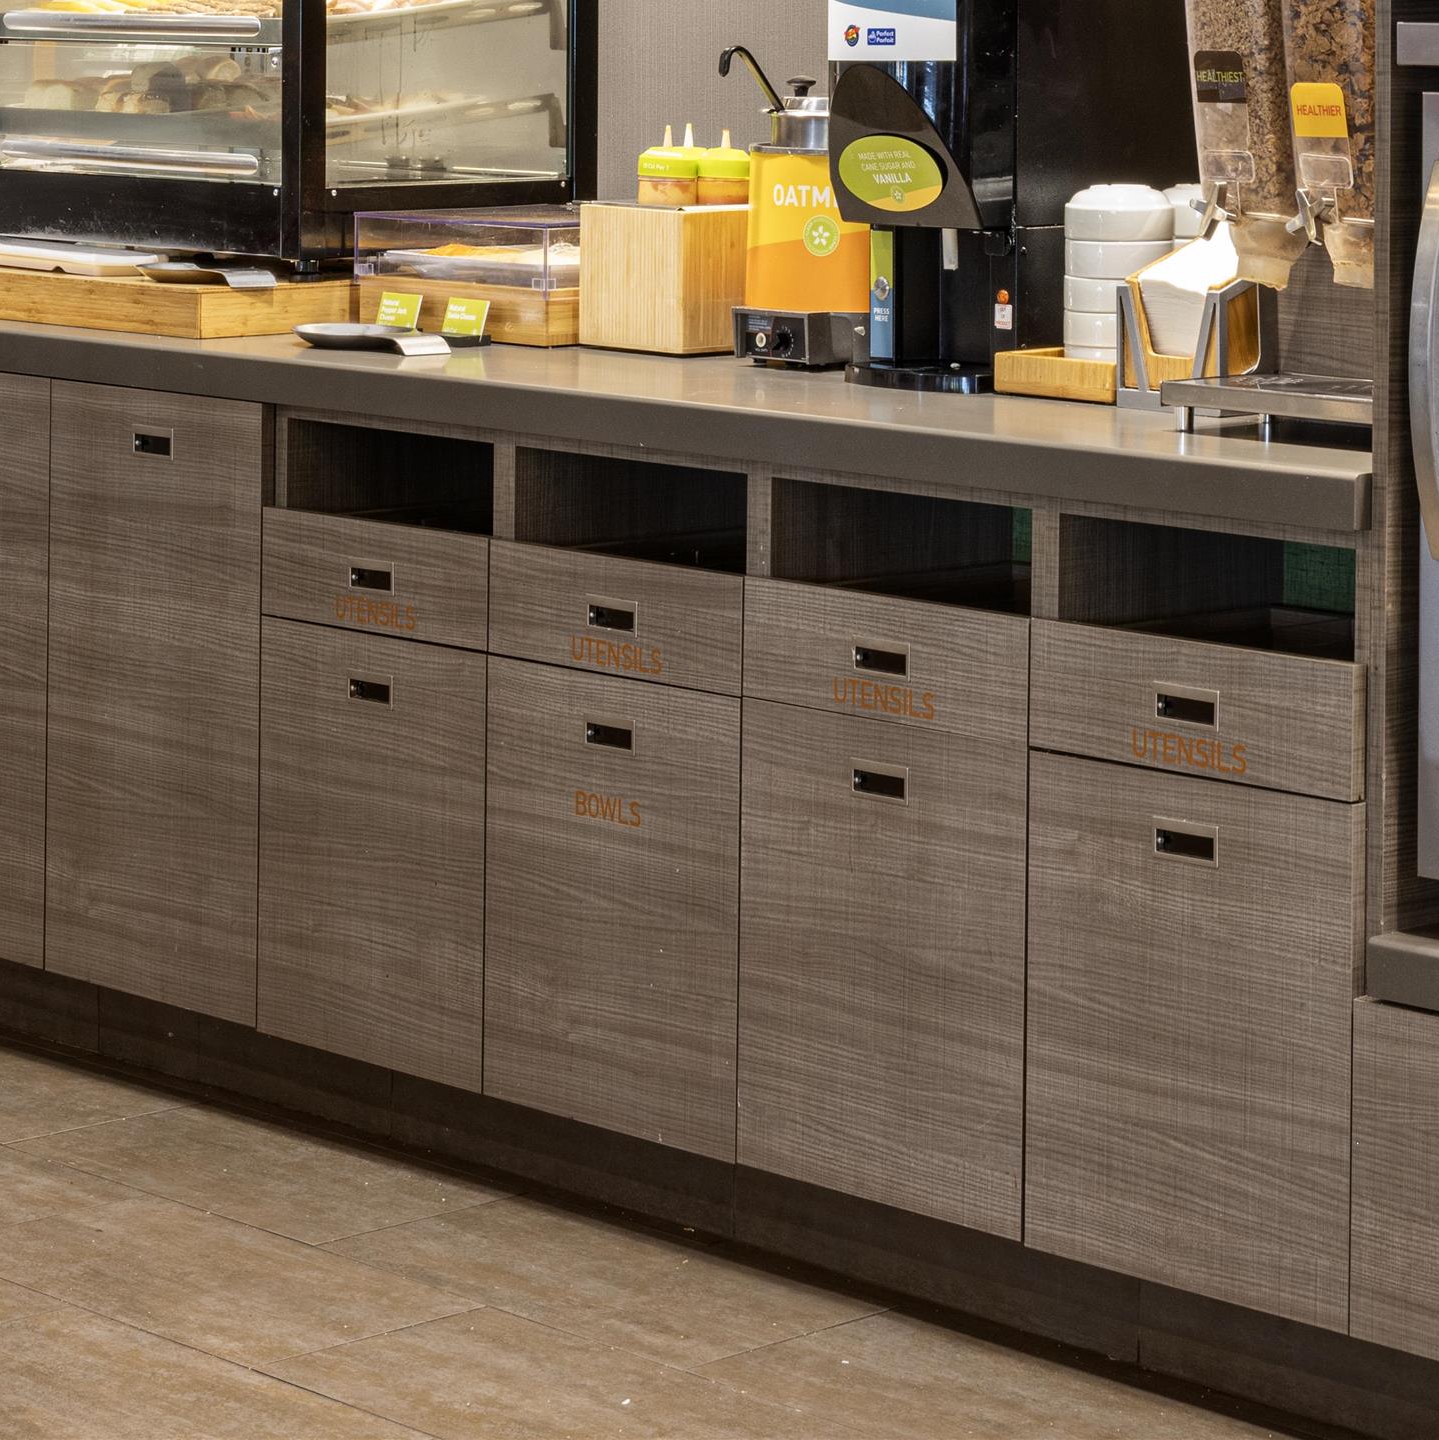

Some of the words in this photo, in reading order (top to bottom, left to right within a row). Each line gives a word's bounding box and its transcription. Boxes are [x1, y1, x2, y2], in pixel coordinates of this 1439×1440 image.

[1196, 69, 1244, 83] HEALTHIEST
[1296, 105, 1342, 117] HEALTHIER
[858, 152, 876, 160] MADE
[877, 151, 893, 160] WITH
[893, 150, 911, 159] REAL
[861, 163, 879, 171] CANE
[879, 161, 901, 170] SUGAR
[902, 160, 916, 169] AND
[873, 172, 912, 184] VANILLA
[772, 183, 838, 208] OATM
[873, 307, 890, 315] PRESS
[334, 595, 418, 631] UTENSILS
[571, 634, 662, 675] UTENSILS
[833, 675, 936, 721] UTENSILS
[1131, 726, 1249, 775] UTENSILS
[574, 789, 642, 828] BOWLS
